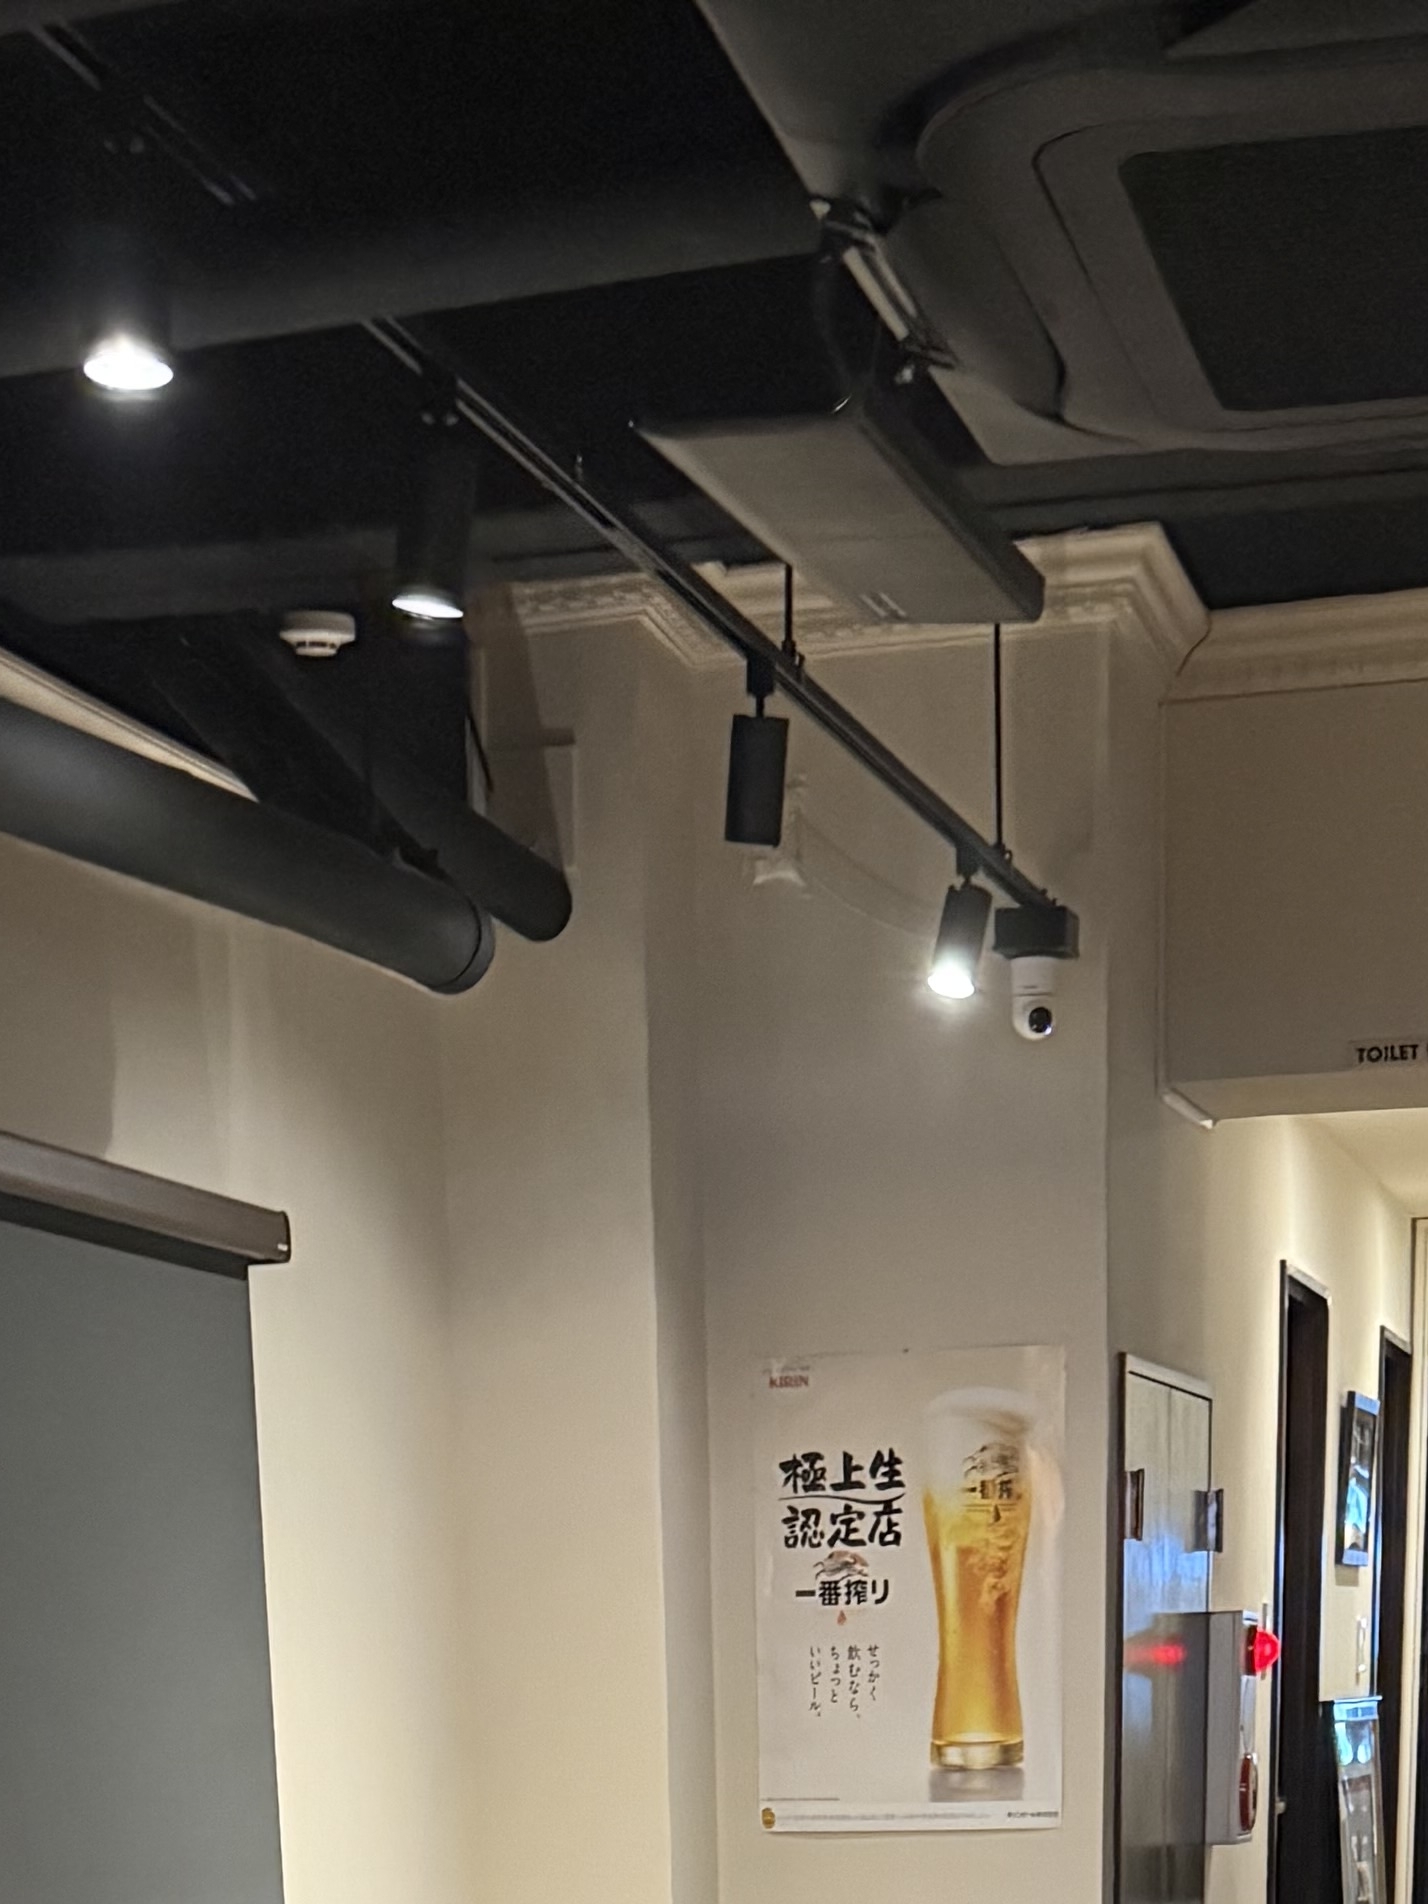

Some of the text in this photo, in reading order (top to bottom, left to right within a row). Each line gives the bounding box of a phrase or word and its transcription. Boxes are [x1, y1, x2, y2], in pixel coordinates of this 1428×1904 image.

[1355, 1044, 1419, 1064] TOILET
[778, 1447, 907, 1494] 極上生
[780, 1501, 904, 1549] 認定店
[795, 1578, 890, 1606] 一番搾り
